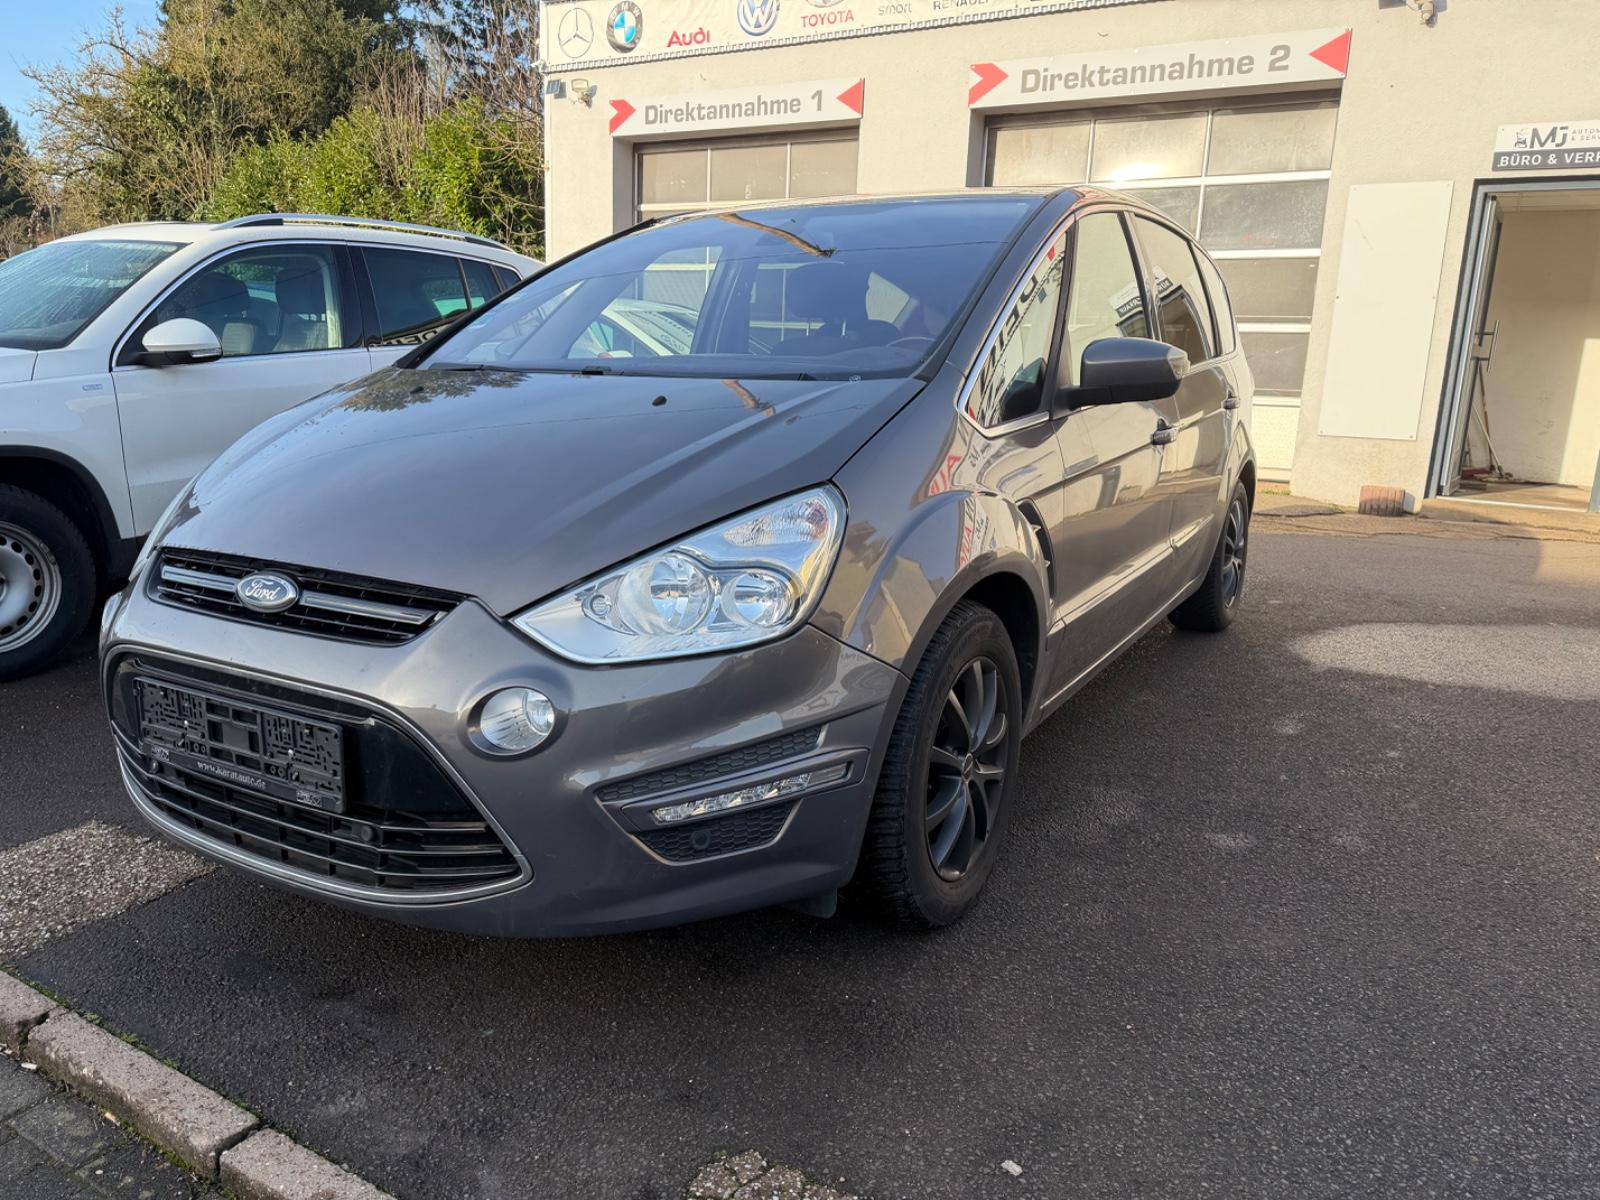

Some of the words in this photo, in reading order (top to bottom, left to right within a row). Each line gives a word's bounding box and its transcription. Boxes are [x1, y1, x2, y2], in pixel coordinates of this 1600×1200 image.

[801, 10, 854, 28] TOYOTA
[667, 27, 711, 48] Audi
[1020, 53, 1255, 93] Direktannahme
[1268, 45, 1291, 73] 2
[644, 96, 801, 126] Direktannahme
[810, 90, 824, 112] 1
[1529, 126, 1568, 149] MJ
[1499, 153, 1542, 167] BÜRO
[1547, 153, 1557, 165] &
[245, 578, 281, 601] Ford
